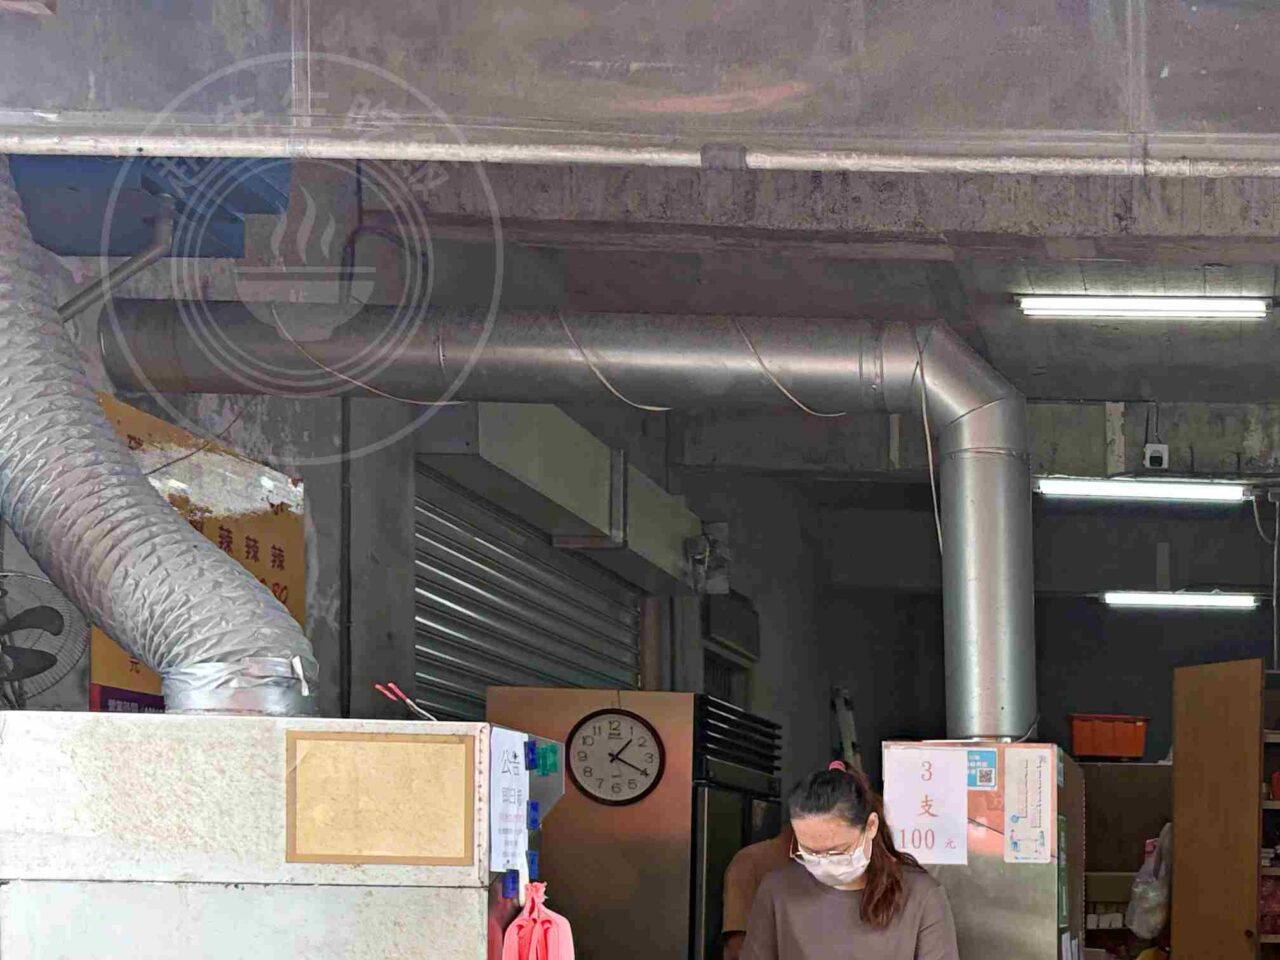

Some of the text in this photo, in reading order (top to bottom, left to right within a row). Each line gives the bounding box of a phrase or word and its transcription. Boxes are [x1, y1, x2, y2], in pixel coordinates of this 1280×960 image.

[592, 725, 602, 736] 11
[608, 720, 621, 731] 12
[582, 735, 594, 747] 10
[638, 737, 648, 748] 2
[577, 751, 587, 762] 9
[643, 752, 654, 764] 3
[583, 766, 593, 778] 8
[920, 760, 933, 782] 3
[595, 778, 604, 789] 7
[611, 782, 622, 794] 6
[627, 778, 638, 790] 5
[917, 794, 938, 818] 支
[900, 828, 936, 850] 100
